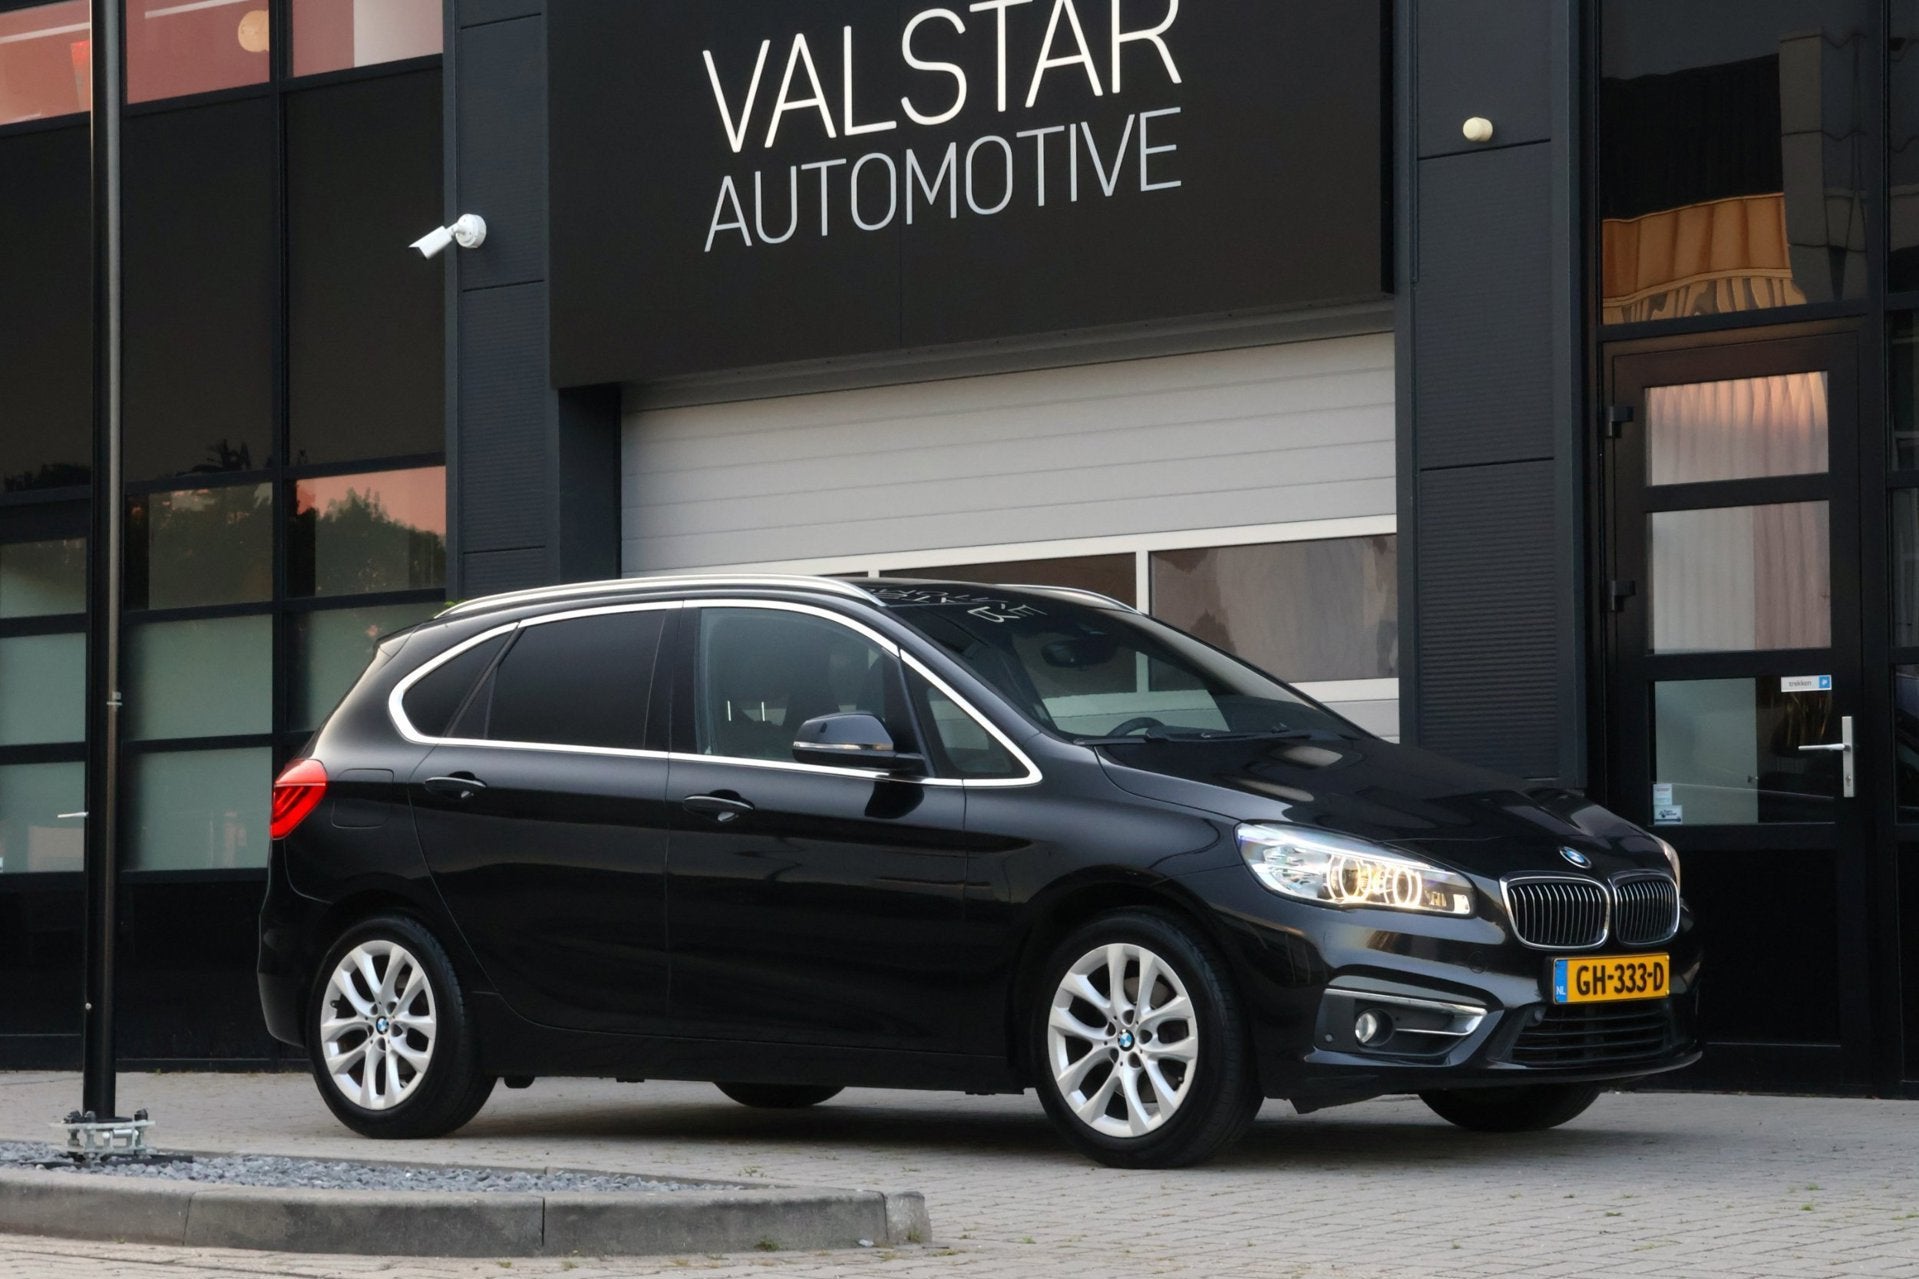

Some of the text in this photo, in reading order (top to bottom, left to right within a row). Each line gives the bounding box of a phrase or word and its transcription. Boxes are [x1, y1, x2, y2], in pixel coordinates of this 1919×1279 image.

[702, 0, 1183, 153] VALSTAR
[704, 107, 1182, 252] AUTOMOTIVE
[1556, 962, 1664, 996] NL GH-333-D
